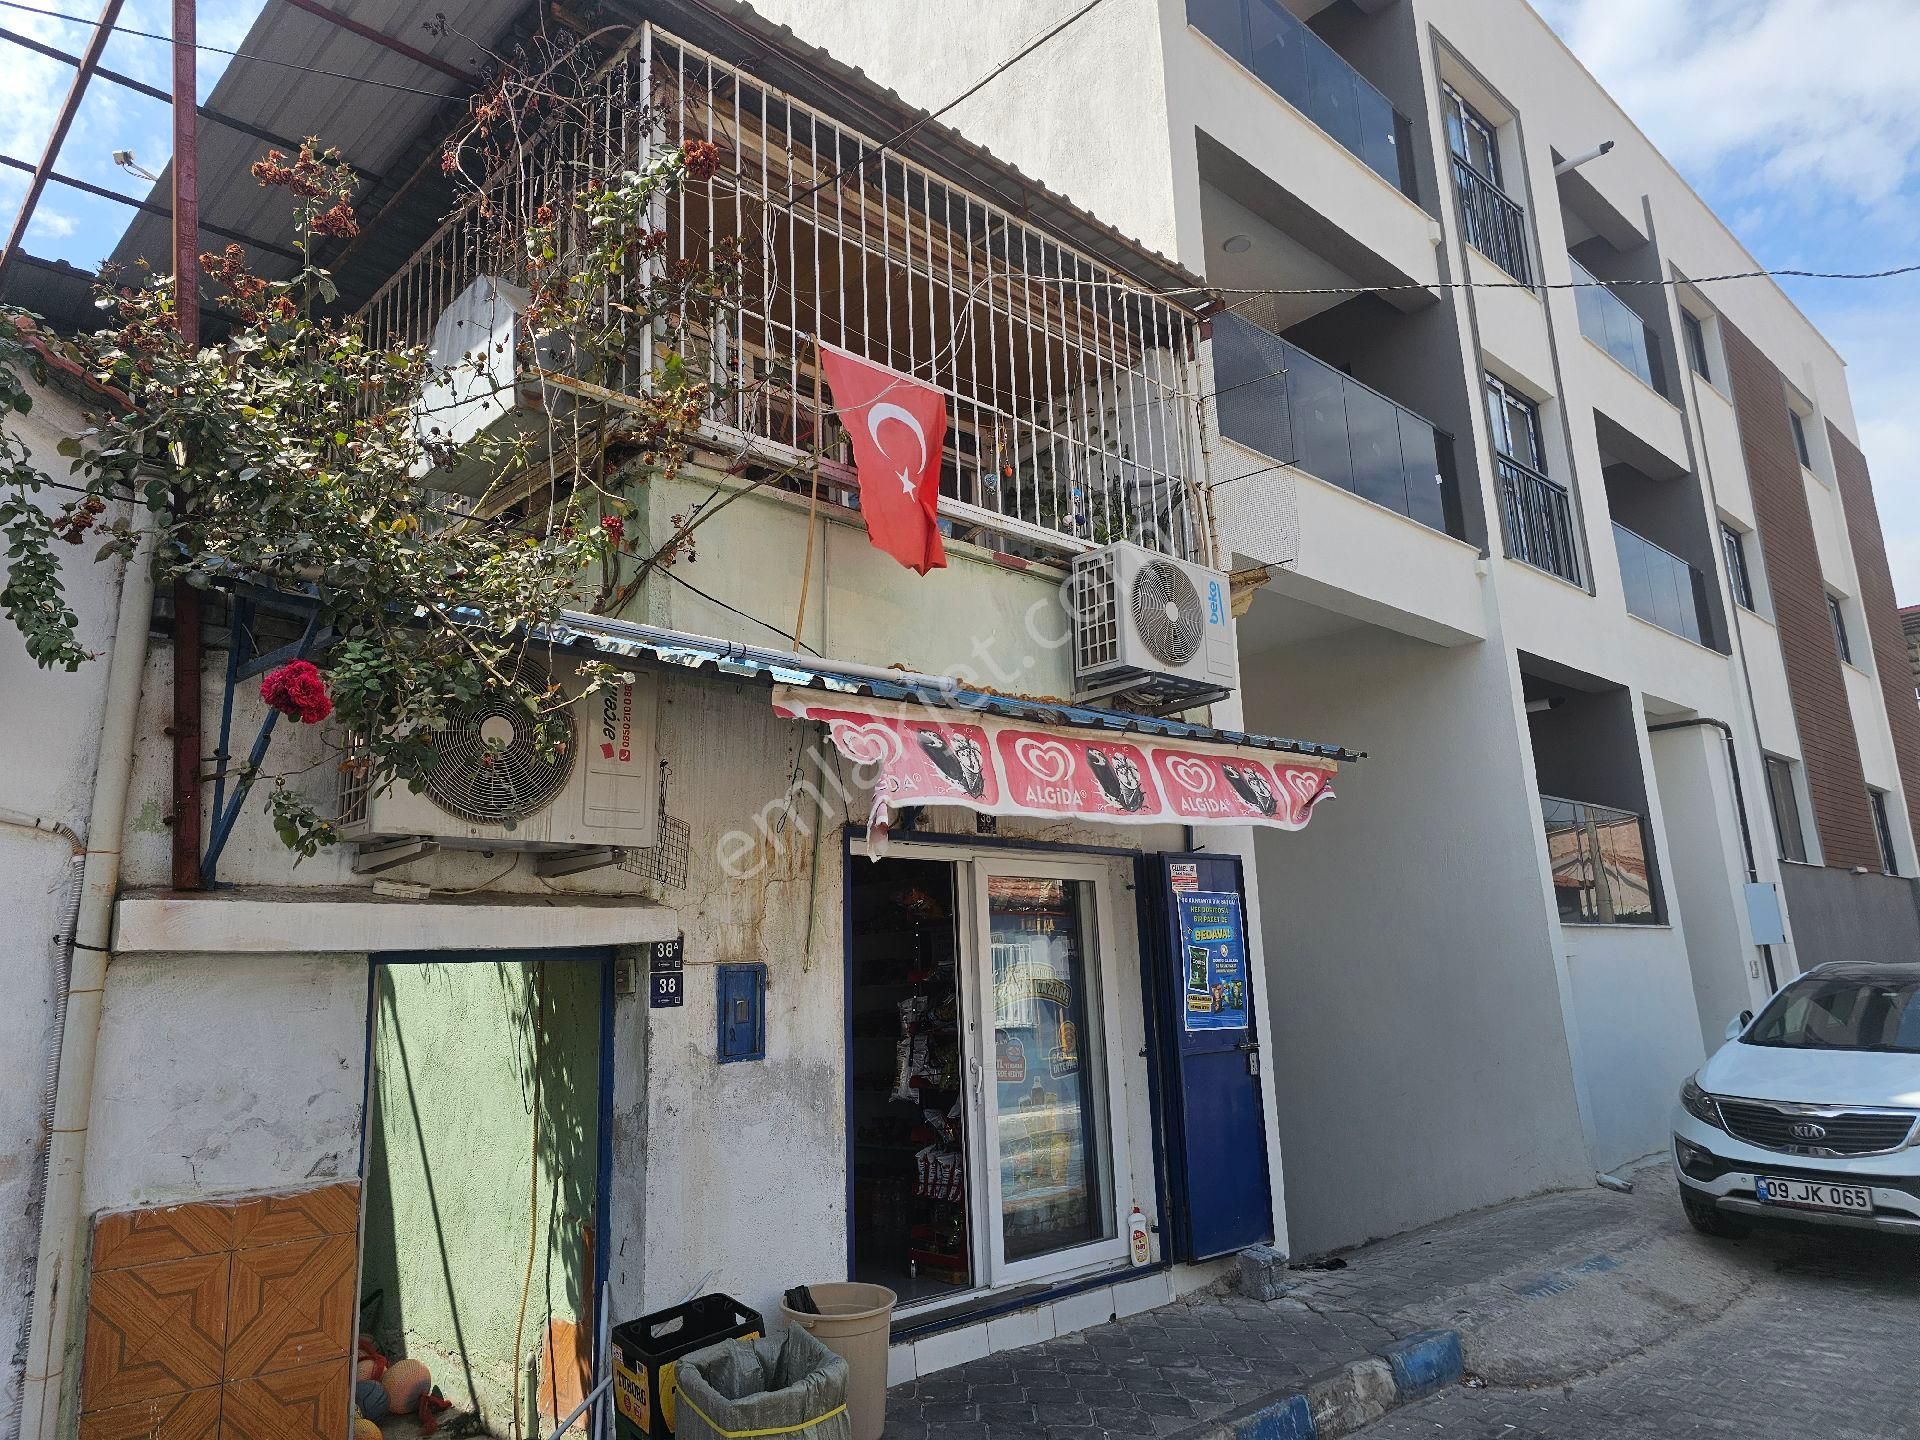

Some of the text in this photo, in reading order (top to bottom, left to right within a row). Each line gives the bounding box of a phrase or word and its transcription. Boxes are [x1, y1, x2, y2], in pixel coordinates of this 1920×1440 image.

[1208, 581, 1218, 625] beko
[1195, 928, 1231, 940] BEDAVA!
[660, 978, 675, 993] 38
[1794, 1126, 1820, 1138] KIA
[1767, 1181, 1867, 1207] 09 JK 065
[617, 1370, 646, 1406] TUBORG
